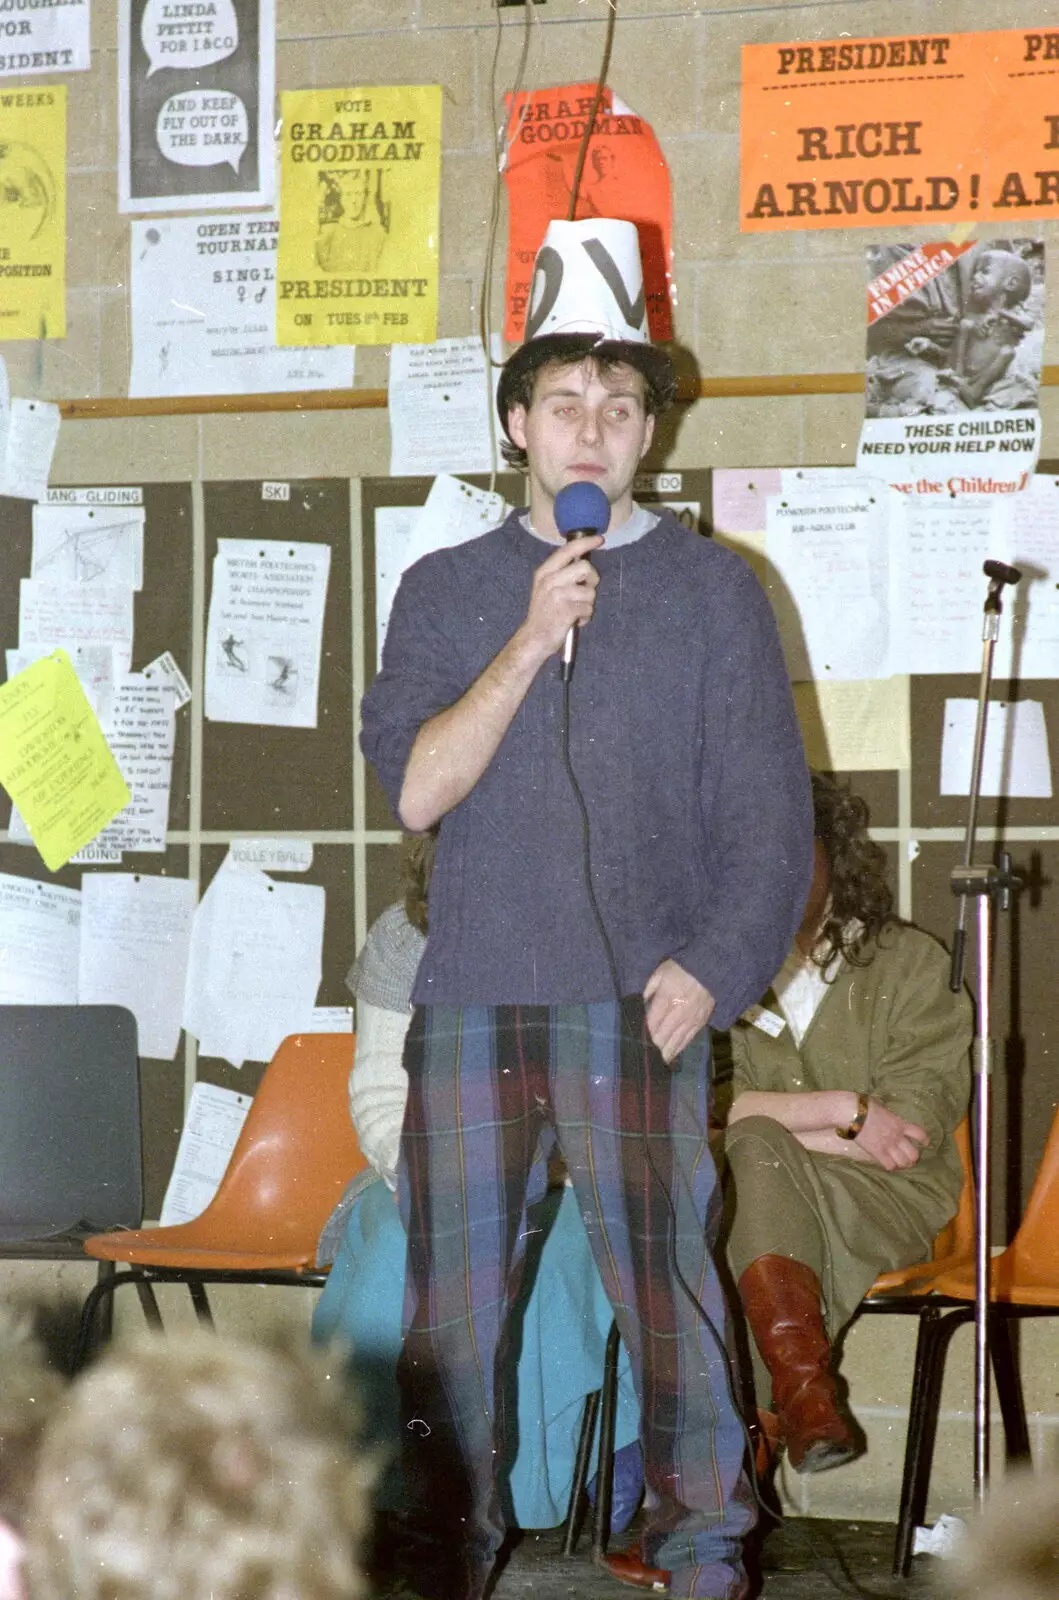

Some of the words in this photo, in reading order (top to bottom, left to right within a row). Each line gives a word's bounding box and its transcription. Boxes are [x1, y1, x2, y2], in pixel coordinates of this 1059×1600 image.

[162, 3, 216, 17] LINDA
[157, 21, 213, 36] PETTIT
[160, 39, 188, 52] FOR
[778, 38, 950, 74] PRESIDENT
[1, 93, 55, 107] WEEKS
[167, 100, 196, 112] AND
[202, 97, 237, 110] KEEP
[335, 101, 372, 113] VOTE
[163, 117, 185, 130] FLY
[190, 116, 218, 128] OUT
[221, 115, 238, 127] OF
[291, 123, 415, 141] GRAHAM
[170, 134, 196, 147] THE
[797, 121, 922, 162] RICH
[291, 143, 422, 162] GOODMAN
[198, 223, 241, 236] OPEN
[868, 253, 928, 298] FAMINE
[871, 293, 893, 316] IN
[896, 249, 953, 299] AFRICA
[280, 279, 428, 300] PRESIDENT
[294, 313, 312, 325] ON
[327, 312, 360, 325] TUES
[383, 312, 413, 325] FEB
[905, 424, 954, 437] THESE
[959, 419, 1035, 435] CHILDREN
[862, 442, 904, 454] NEED
[909, 441, 950, 454] YOUR
[955, 440, 995, 452] HELP
[999, 438, 1034, 452] NOW
[661, 478, 679, 489] DO
[917, 479, 943, 492] the
[948, 478, 1016, 496] Children
[265, 486, 287, 498] SKI
[232, 849, 308, 863] VOLLEYBALL
